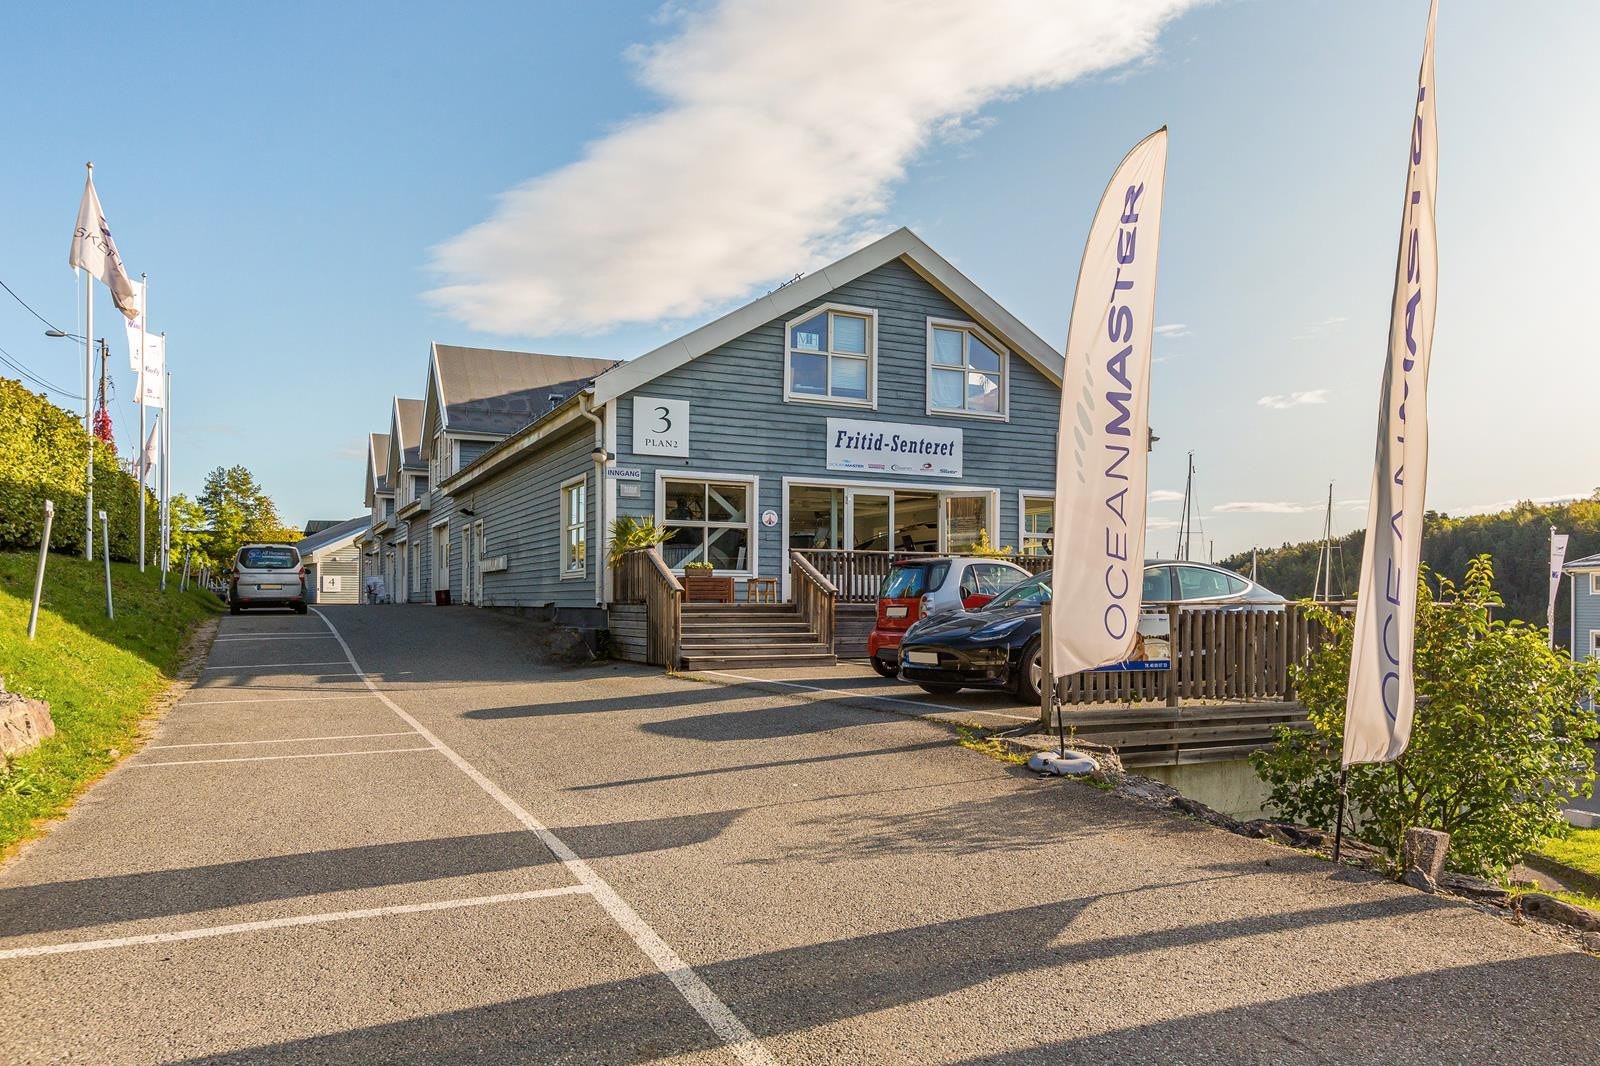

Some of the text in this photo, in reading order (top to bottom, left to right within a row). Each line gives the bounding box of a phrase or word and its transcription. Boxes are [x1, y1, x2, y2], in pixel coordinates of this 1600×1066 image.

[651, 406, 672, 434] 3
[1104, 181, 1144, 640] OCEANMASTER
[834, 430, 955, 456] Fritid-Senteret
[607, 469, 640, 478] INNGANG
[328, 577, 335, 587] 4
